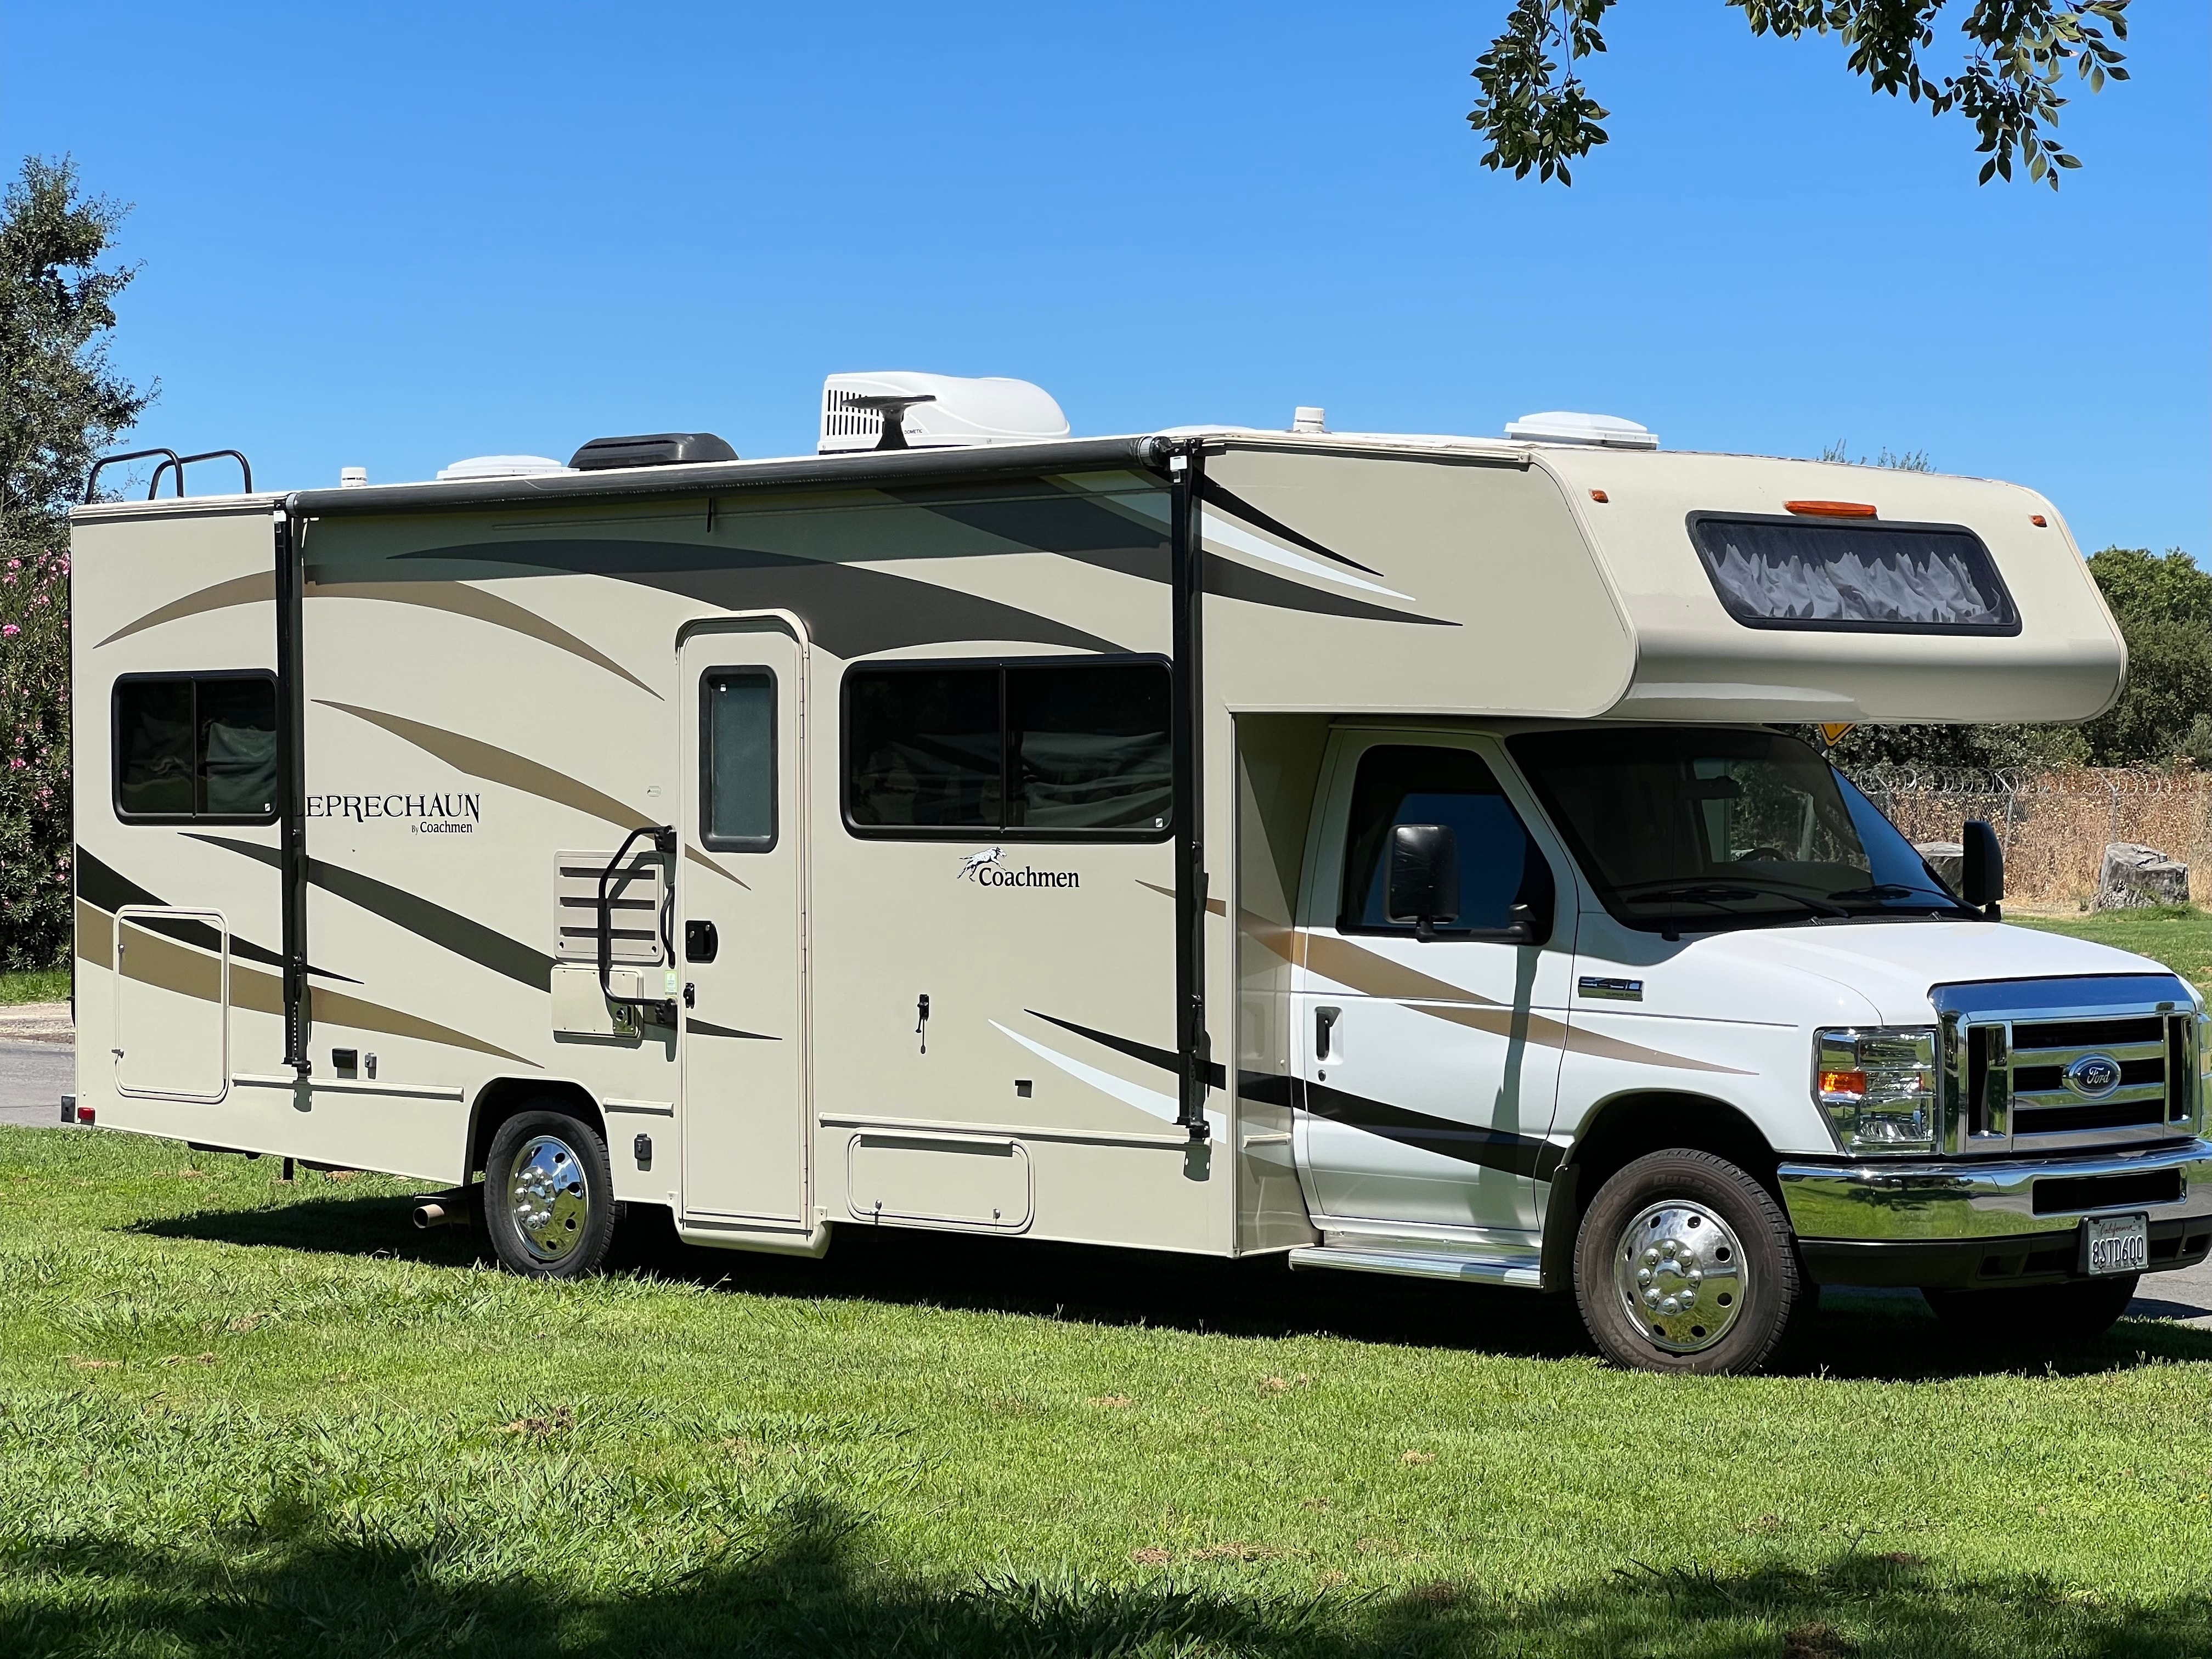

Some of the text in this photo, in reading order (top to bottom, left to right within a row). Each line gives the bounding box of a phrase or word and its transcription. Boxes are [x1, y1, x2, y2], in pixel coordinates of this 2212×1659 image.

[306, 793, 480, 823] EPRECHAUN
[411, 821, 473, 835] By Coachmen
[979, 866, 1080, 887] Coachmen
[2086, 1066, 2111, 1084] Ford
[2100, 1222, 2136, 1237] California
[2091, 1235, 2143, 1265] 8STD600
